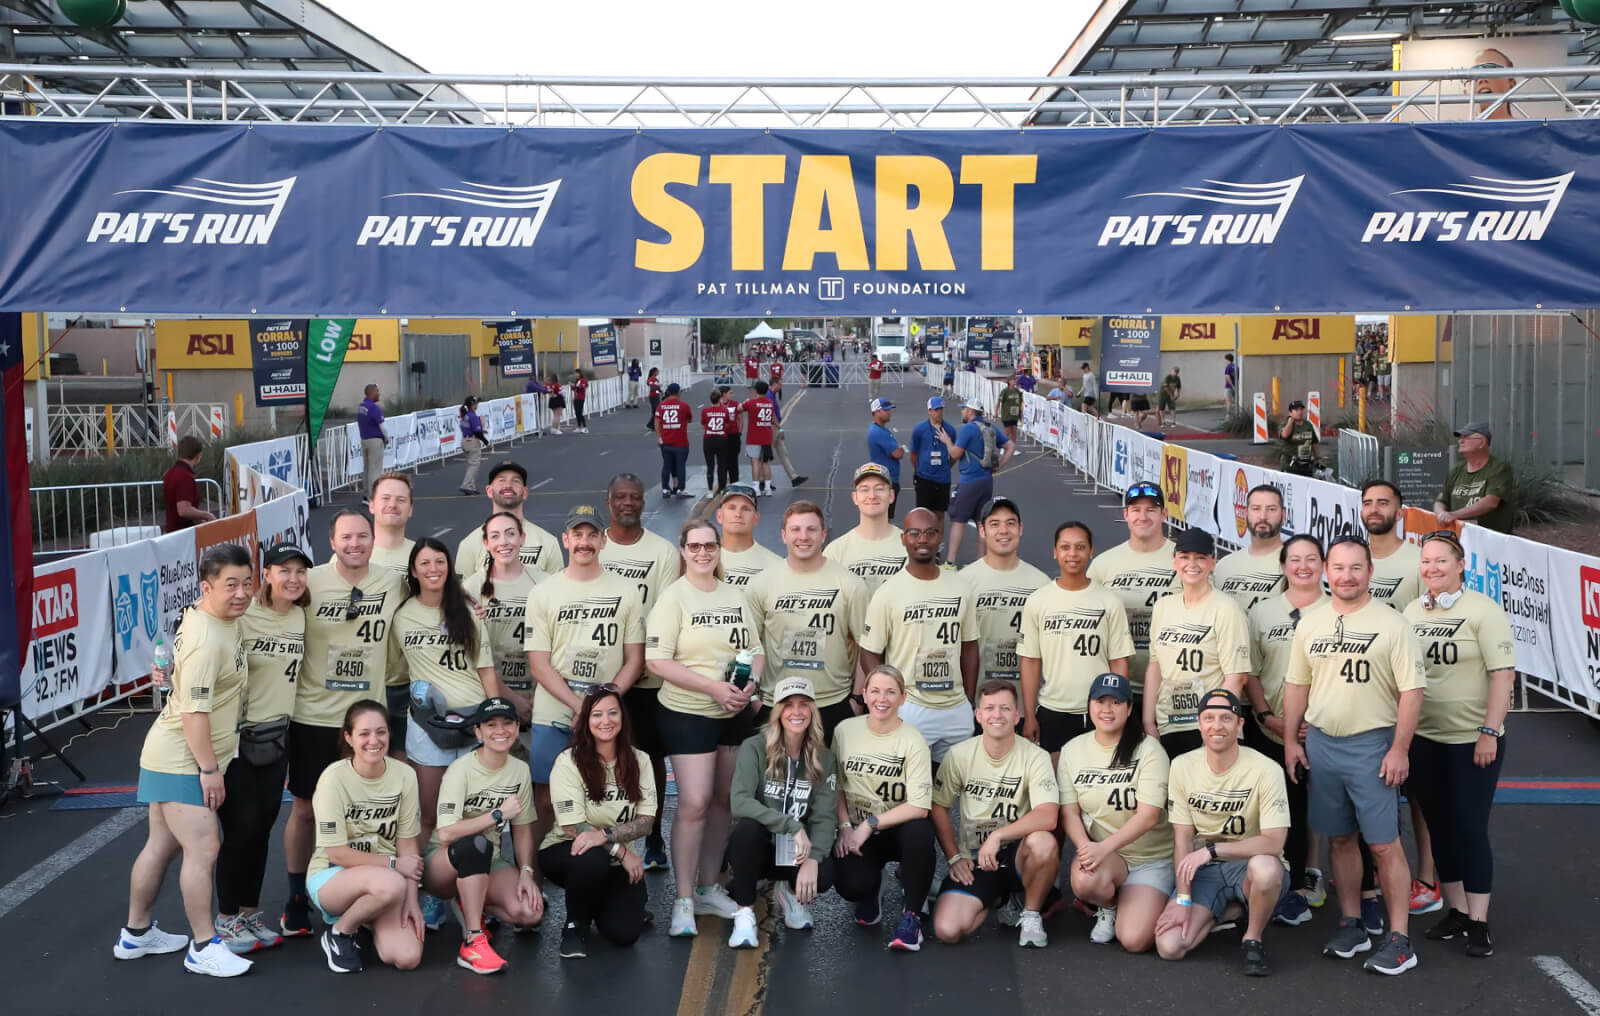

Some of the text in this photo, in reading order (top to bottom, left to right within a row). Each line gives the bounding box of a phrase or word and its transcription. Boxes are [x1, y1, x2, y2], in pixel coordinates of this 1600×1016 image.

[630, 152, 1038, 272] START
[87, 205, 279, 244] PAT'S RUN
[356, 209, 541, 247] PAT'S RUN
[1098, 206, 1285, 247] PAT'S RUN
[1361, 203, 1553, 243] PAT'S RUN
[697, 282, 727, 295] PAT
[734, 282, 810, 295] TILLMAN
[853, 282, 966, 295] FOUNDATION
[1109, 318, 1156, 330] CORRAL 1
[1179, 323, 1216, 340] ASU
[1272, 318, 1320, 340] ASU
[256, 331, 296, 342] CORRAL
[349, 334, 372, 350] SU
[1113, 330, 1118, 338] 1
[1128, 330, 1150, 338] 1000
[187, 334, 234, 356] ASU
[262, 343, 268, 352] 1
[276, 342, 298, 350] 1000
[263, 384, 304, 394] U-HAUL
[662, 410, 678, 423] 42
[758, 408, 772, 421] 42
[708, 418, 724, 430] 42
[160, 560, 194, 586] BlueCross
[624, 566, 650, 580] RUN
[878, 563, 904, 576] RUN
[1112, 575, 1174, 588] PAT'S RUN
[1222, 579, 1278, 593] PAT'S RUN
[1502, 564, 1544, 595] BlueCross
[1373, 584, 1396, 598] RUN
[32, 583, 75, 629] KTAR
[360, 601, 384, 616] RUN
[775, 596, 836, 610] PAT'S RUN
[976, 596, 1027, 608] PAT'S RU
[558, 604, 619, 622] PAT'S RUN
[692, 613, 744, 626] PAT'S RUN
[904, 604, 960, 621] PAT'S RUN
[356, 619, 386, 642] 40
[808, 613, 835, 636] 40
[1044, 616, 1102, 631] PAT'S RUN
[1428, 624, 1460, 638] RUN
[404, 634, 436, 646] PAT'S
[592, 623, 618, 646] 40
[729, 628, 750, 650] 40
[936, 622, 960, 644] 40
[1180, 631, 1207, 645] RUN
[33, 632, 77, 674] NEWS
[252, 640, 286, 653] PAT'S
[792, 640, 817, 656] 4473
[1073, 634, 1100, 656] 40
[1310, 640, 1373, 655] PAT'S RUN
[1426, 641, 1458, 665] 40
[336, 660, 364, 676] 8450
[438, 650, 468, 670] 40
[1176, 648, 1204, 672] 40
[572, 660, 598, 678] 8551
[922, 662, 950, 678] 10270
[1340, 658, 1370, 684] 40
[1172, 692, 1199, 710] 15650
[846, 760, 904, 778] PAT'S RUN
[1074, 770, 1136, 785] PAT'S RUN
[875, 781, 906, 802] 40
[965, 784, 1018, 799] PAT'S RUN
[1108, 788, 1138, 812] 40
[1188, 796, 1221, 812] PAT'S
[372, 805, 398, 820] RUN
[788, 802, 808, 822] 40
[992, 802, 1018, 823] 40
[1222, 815, 1246, 836] 40
